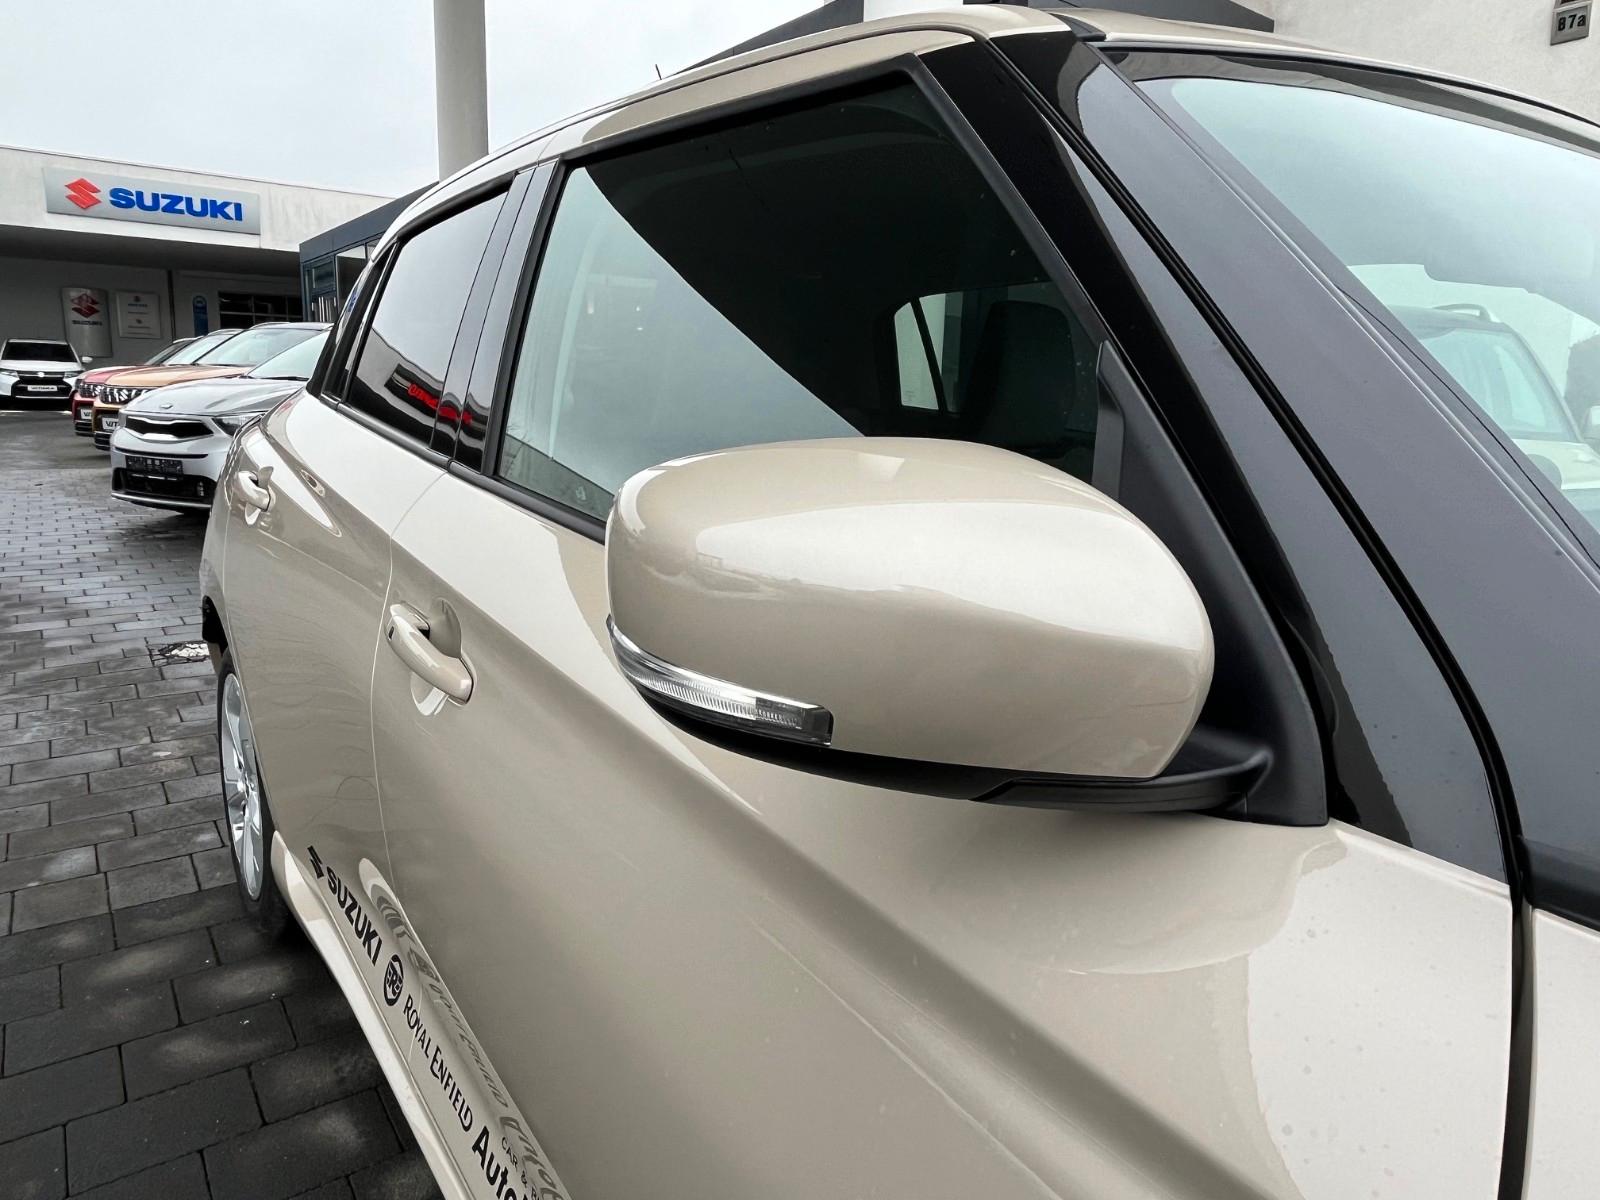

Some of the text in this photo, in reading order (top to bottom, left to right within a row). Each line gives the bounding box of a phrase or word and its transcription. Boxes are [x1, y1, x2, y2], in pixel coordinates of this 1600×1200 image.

[1558, 13, 1586, 31] 87a
[109, 187, 243, 221] SUZUKI
[326, 866, 383, 966] SUZUKI
[403, 994, 430, 1059] ROYAL
[430, 1045, 473, 1132] ENFIELD
